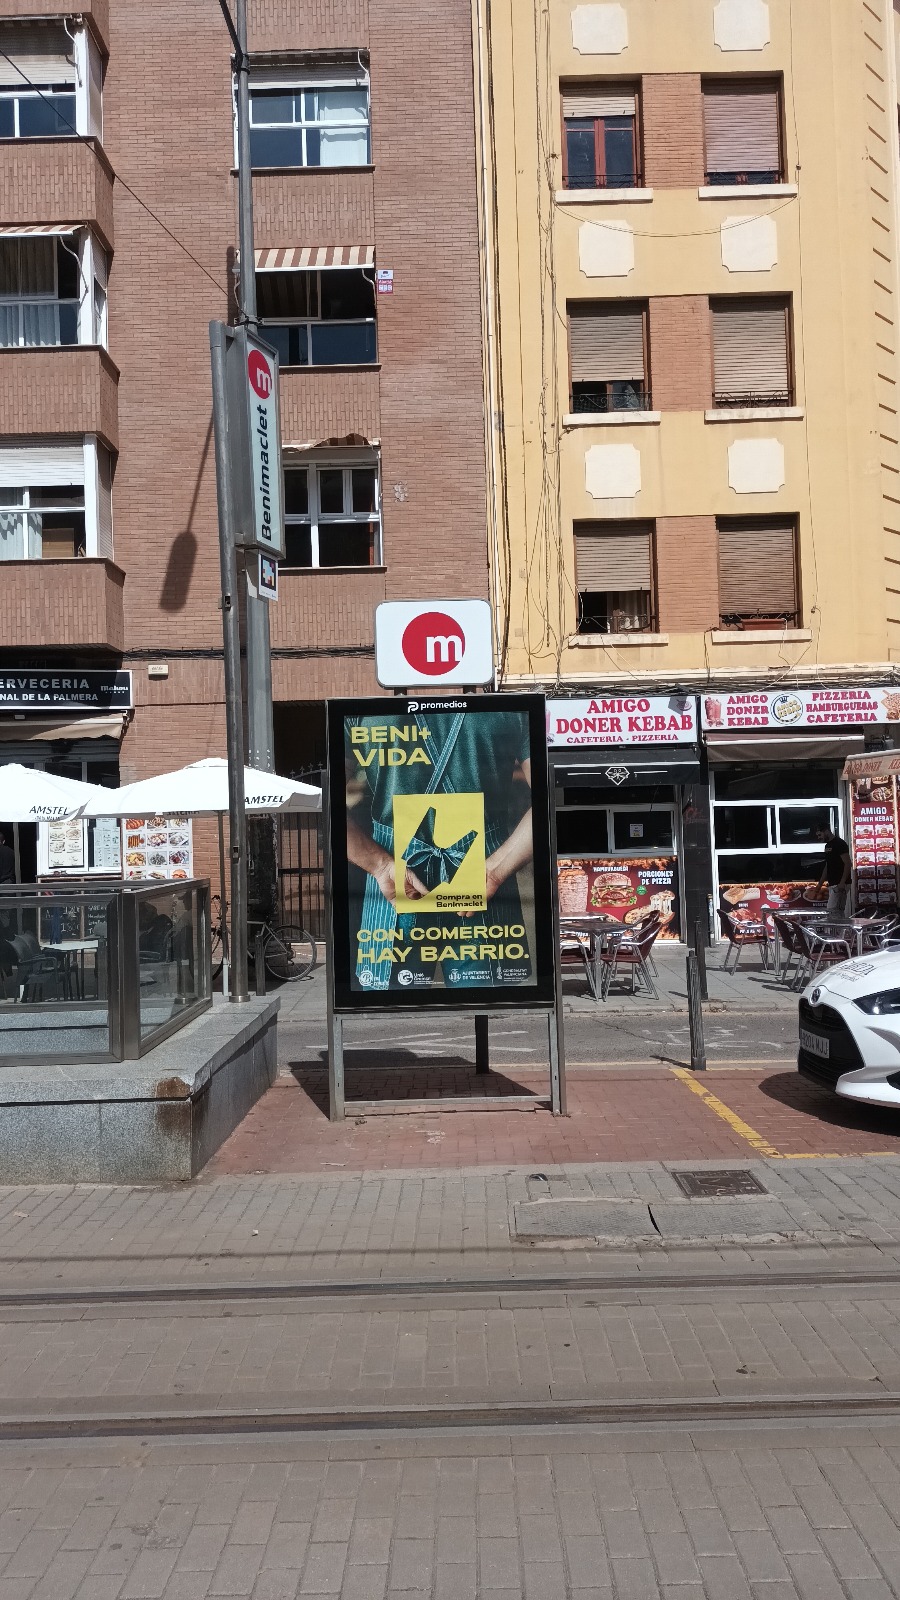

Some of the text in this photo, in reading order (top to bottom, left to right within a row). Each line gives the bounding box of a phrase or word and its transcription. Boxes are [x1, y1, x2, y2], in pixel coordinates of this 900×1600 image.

[256, 404, 273, 542] Benimaclet
[22, 693, 36, 701] DE
[37, 693, 51, 701] LA
[53, 693, 99, 701] PALMERA
[727, 694, 769, 705] AMIGO
[811, 690, 871, 701] PIZZERIA
[420, 701, 468, 711] promedios
[587, 699, 651, 714] AMIGO
[726, 706, 769, 716] DONER
[806, 701, 879, 712] HAMBURGUESAS
[727, 716, 769, 727] KEBAB
[806, 712, 878, 723] CAFETERIA
[556, 715, 693, 735] DONER KEBAB
[351, 725, 432, 744] BENI+
[566, 736, 624, 744] CAFETERIA
[631, 734, 679, 742] PIZZERIA
[352, 747, 432, 768] VIDA
[245, 795, 285, 805] AMSTEL
[28, 805, 69, 816] AMSTEL
[860, 806, 887, 816] AMIGO
[638, 870, 674, 878] PORCIONES
[436, 900, 484, 908] Benimaclet
[356, 924, 526, 943] CON COMERCIO
[357, 943, 530, 964] HAY BARRIO.
